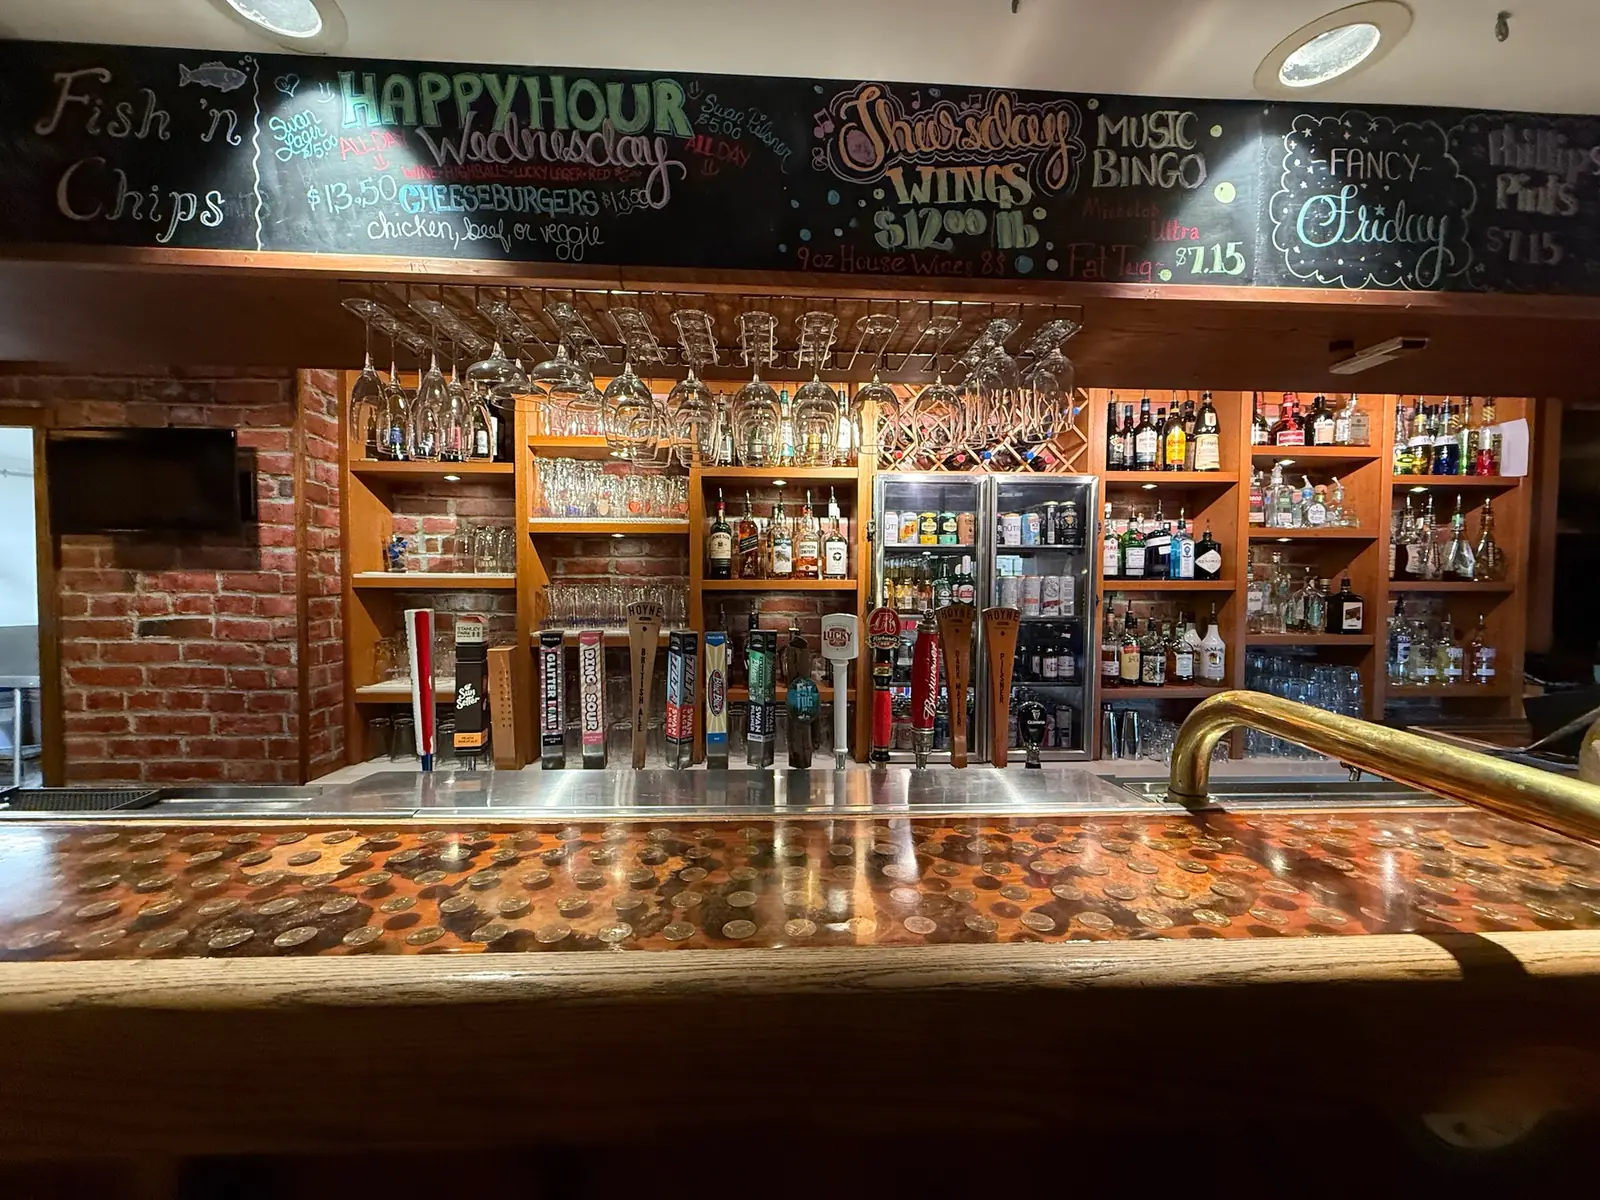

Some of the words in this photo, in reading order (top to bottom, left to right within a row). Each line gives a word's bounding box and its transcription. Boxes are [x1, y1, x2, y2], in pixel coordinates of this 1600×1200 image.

[35, 67, 171, 140] Fish
[337, 71, 519, 132] HAPPY
[522, 75, 695, 138] HOUR
[701, 93, 745, 124] Swan
[269, 110, 322, 140] Swan
[275, 125, 327, 161] Lager
[838, 86, 1070, 190] Thursday
[1097, 110, 1199, 150] MUSIC
[339, 135, 375, 161] ALL
[369, 130, 408, 152] DAY
[416, 110, 687, 209] Wednesday
[716, 140, 752, 169] DAY
[1091, 148, 1208, 189] BINGO
[1330, 148, 1420, 182] FANCY
[56, 157, 226, 243] Chips
[399, 183, 599, 217] CHEESEBURGERS
[886, 163, 1034, 208] WINGS
[513, 223, 537, 241] or
[540, 221, 604, 261] veggie
[1150, 218, 1200, 241] Ultra
[1296, 184, 1455, 287] Friday
[840, 244, 908, 273] House
[1066, 241, 1111, 278] Fat
[1175, 242, 1246, 276] $7.15
[628, 604, 663, 617] HOYNE
[941, 607, 972, 620] HOYNE
[987, 608, 1020, 622] HOYNE
[823, 630, 853, 642] LUCKY
[546, 653, 557, 698] GLITTER
[584, 648, 597, 685] DINO
[922, 641, 939, 721] Budweiser
[998, 652, 1006, 705] PILSNER
[458, 688, 476, 700] Sun
[585, 693, 598, 731] SOUR
